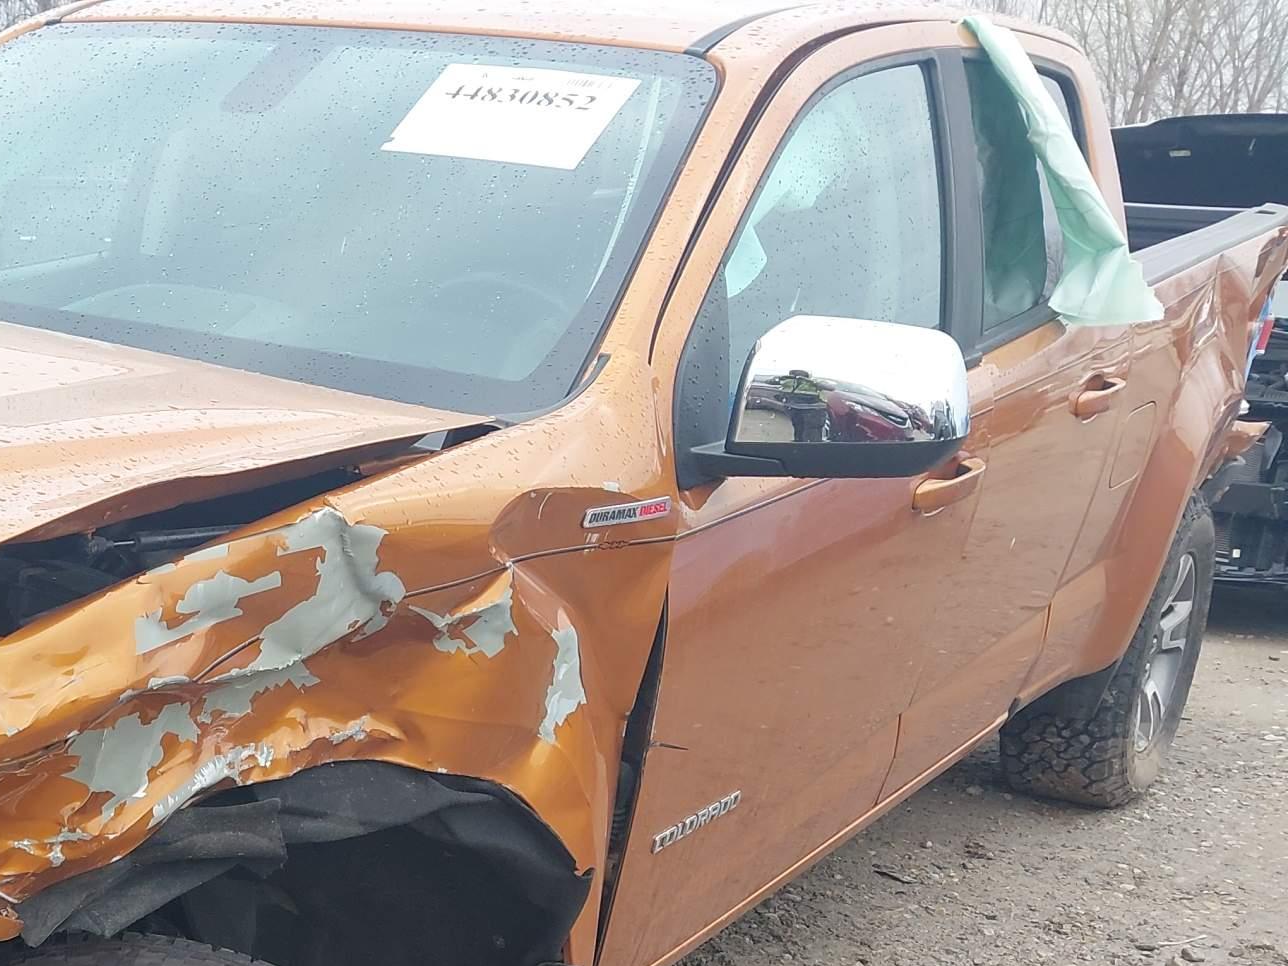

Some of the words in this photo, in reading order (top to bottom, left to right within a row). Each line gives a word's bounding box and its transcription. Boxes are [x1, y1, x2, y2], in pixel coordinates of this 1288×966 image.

[445, 85, 597, 111] 44830852
[589, 507, 639, 524] DURAMAX
[640, 502, 668, 516] DIESEL
[652, 789, 742, 856] COLORADO
